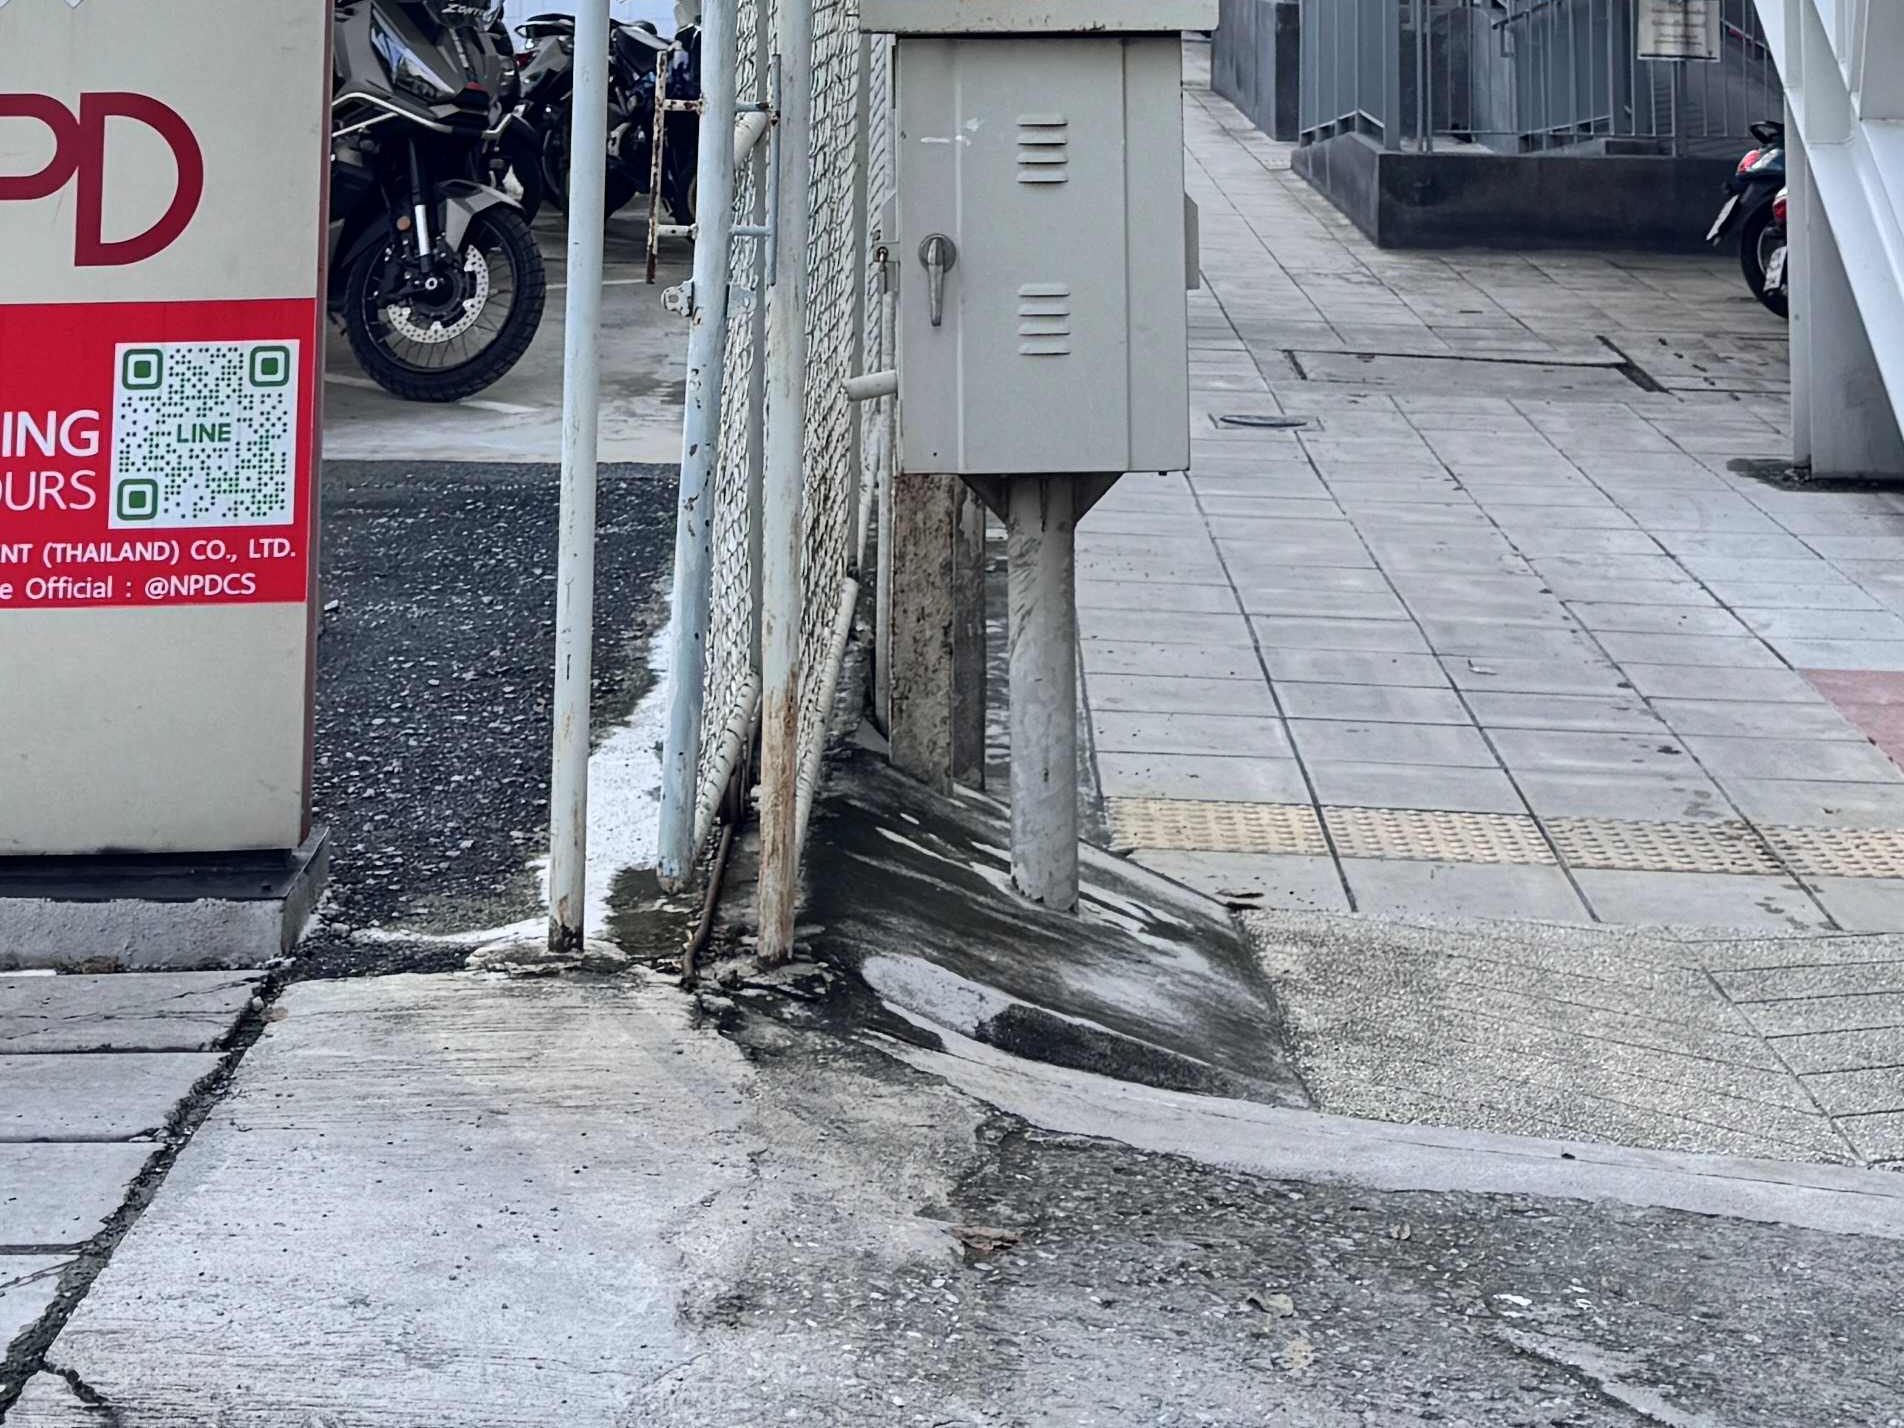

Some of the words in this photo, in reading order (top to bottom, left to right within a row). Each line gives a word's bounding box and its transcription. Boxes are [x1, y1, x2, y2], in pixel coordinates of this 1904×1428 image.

[176, 422, 231, 443] LINE
[42, 540, 179, 568] (THAILAND)
[190, 540, 238, 564] CO.,
[249, 538, 296, 559] LTD.
[25, 574, 113, 600] Official
[144, 572, 256, 600] @NPDCS
